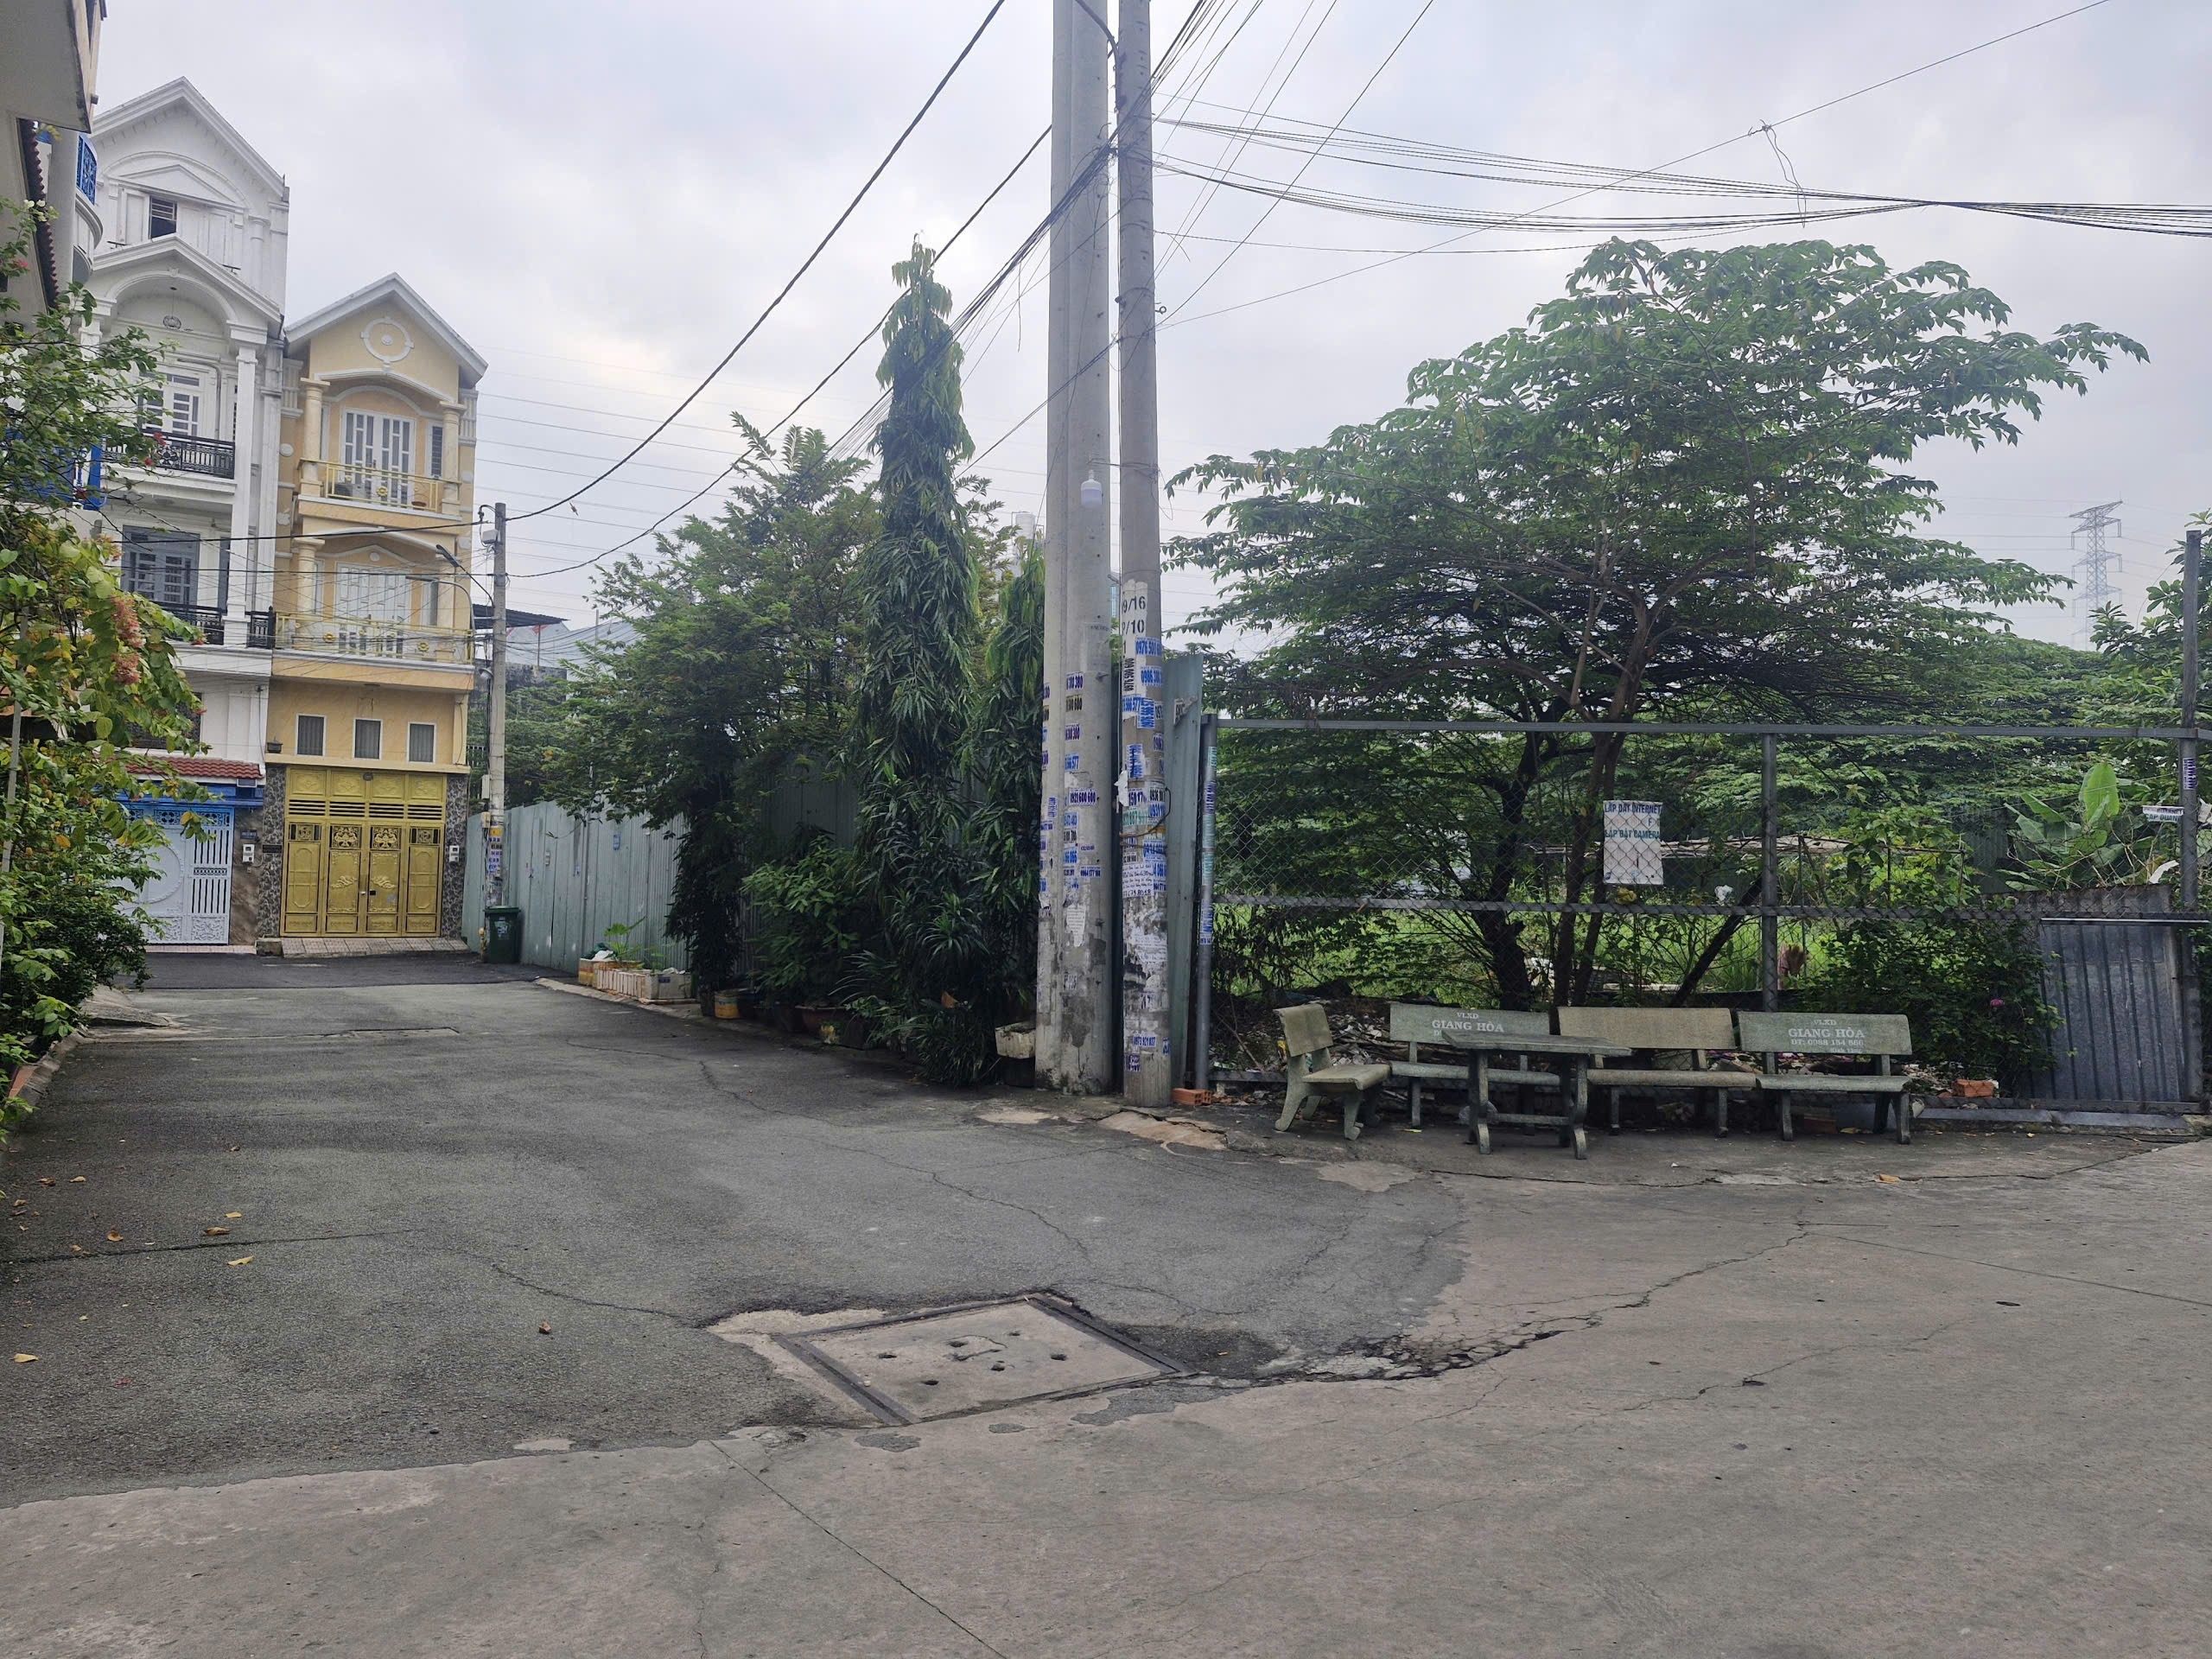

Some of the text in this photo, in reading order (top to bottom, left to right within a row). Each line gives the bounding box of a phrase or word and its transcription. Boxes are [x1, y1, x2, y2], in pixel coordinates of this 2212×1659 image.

[1432, 1020, 1503, 1033] GIANG HÒA
[1788, 1027, 1865, 1038] GIANG HÒA
